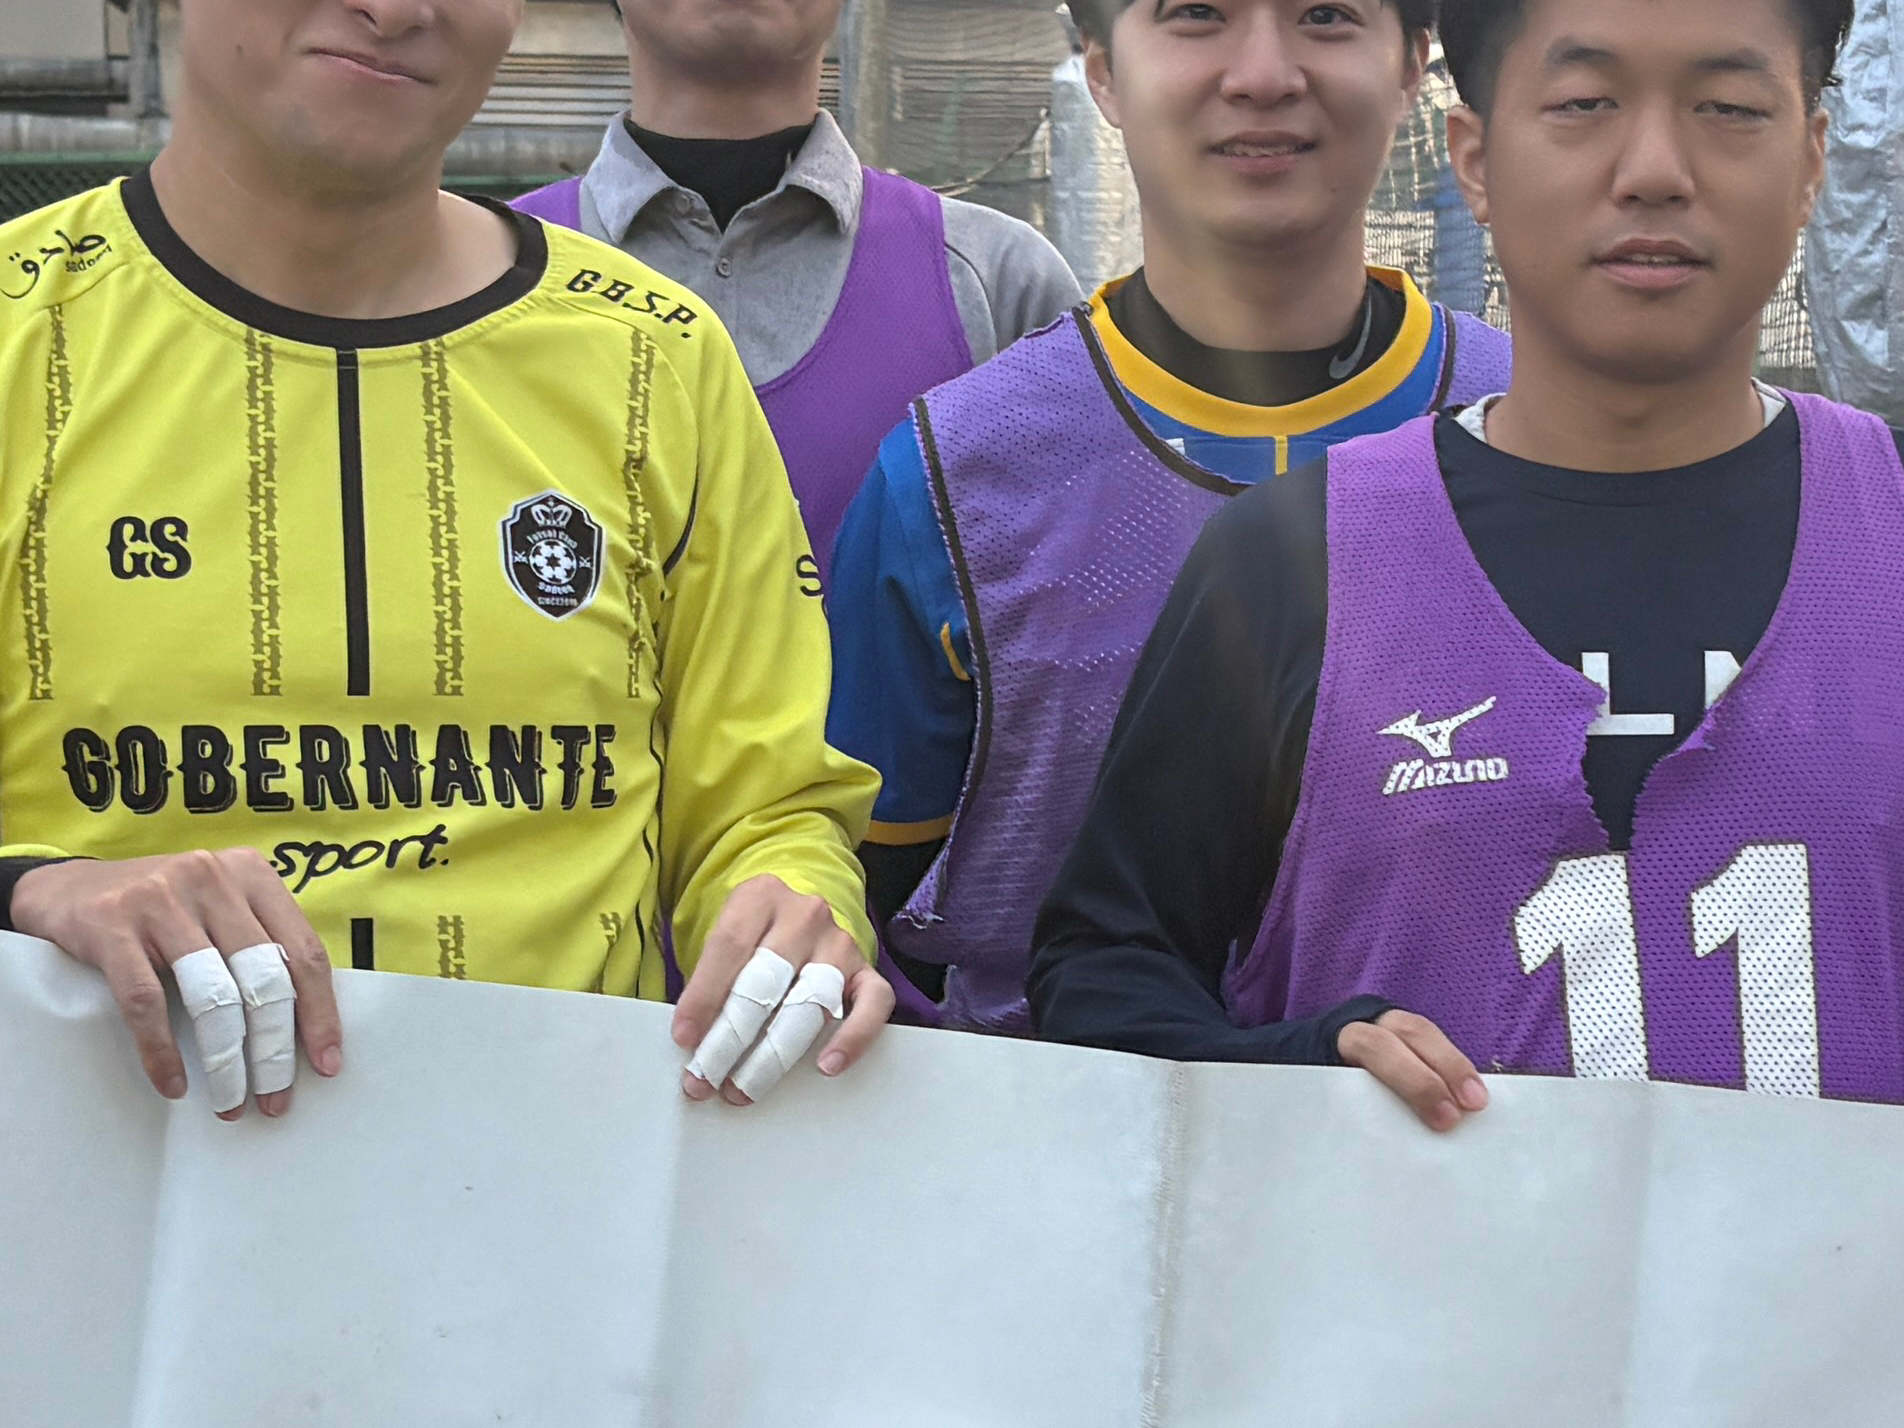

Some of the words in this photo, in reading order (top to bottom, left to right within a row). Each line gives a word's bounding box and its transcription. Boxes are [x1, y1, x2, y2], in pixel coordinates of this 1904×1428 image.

[105, 515, 192, 580] GS
[61, 723, 619, 813] GOBERNANTE
[1513, 843, 1821, 1099] 11
